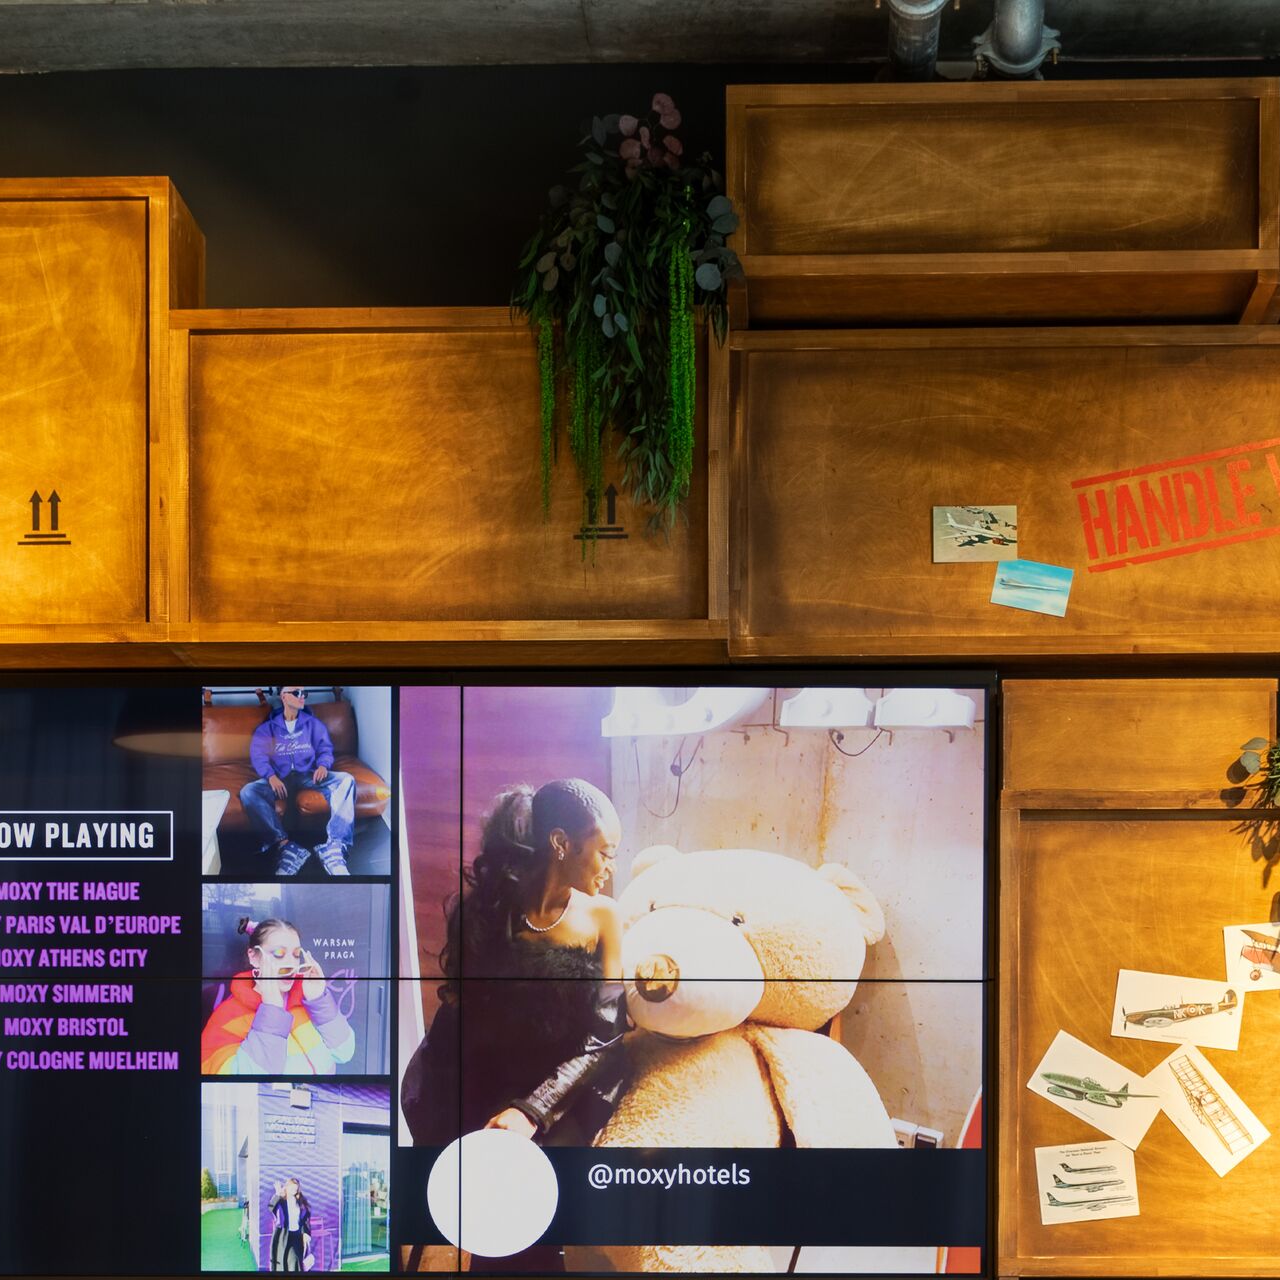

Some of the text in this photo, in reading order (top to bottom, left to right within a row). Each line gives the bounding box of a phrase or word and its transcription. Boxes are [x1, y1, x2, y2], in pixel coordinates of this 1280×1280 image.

[1077, 459, 1261, 560] HANDLE
[45, 821, 154, 849] PLAYING
[45, 881, 80, 901] THE
[83, 881, 140, 901] HAGUE
[5, 915, 56, 935] PARIS
[58, 915, 91, 935] VAL
[313, 938, 355, 947] WARSAW
[38, 948, 106, 968] ATHENS
[109, 948, 148, 968] CITY
[324, 951, 355, 960] PRAGA
[0, 984, 134, 1004] MOXY SIMMERN
[4, 1017, 129, 1037] MOXY BRISTOL
[6, 1050, 85, 1070] COLOGNE
[88, 1050, 179, 1070] MUELHEIM
[587, 1162, 751, 1190] @moxyhotels
